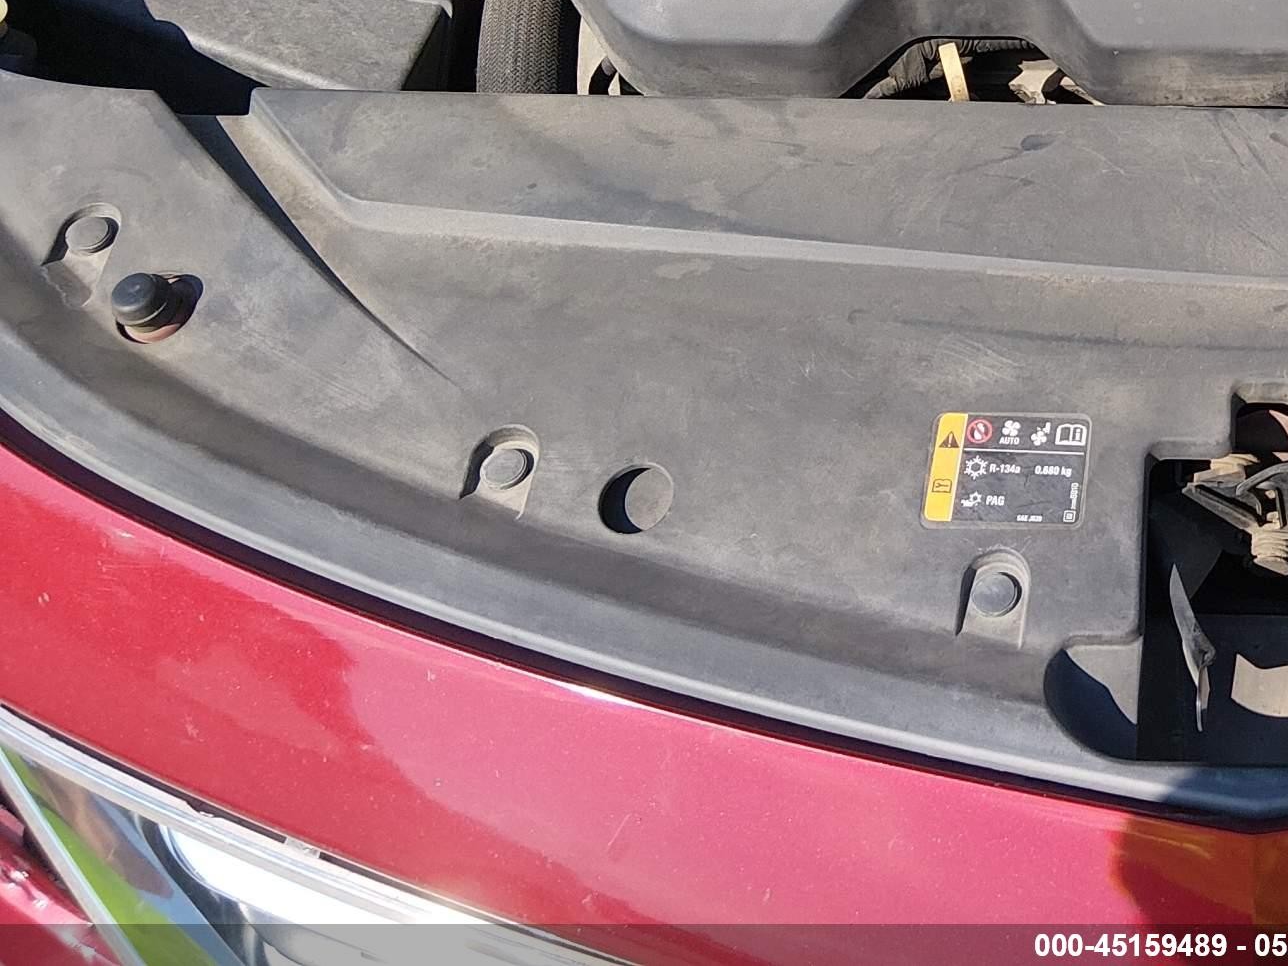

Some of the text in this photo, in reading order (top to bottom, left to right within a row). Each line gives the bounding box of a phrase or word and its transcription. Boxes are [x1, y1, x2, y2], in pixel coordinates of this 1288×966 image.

[998, 436, 1020, 445] AUTO
[989, 464, 1021, 474] R-134a
[1061, 466, 1072, 478] kg
[985, 495, 1005, 506] PAG
